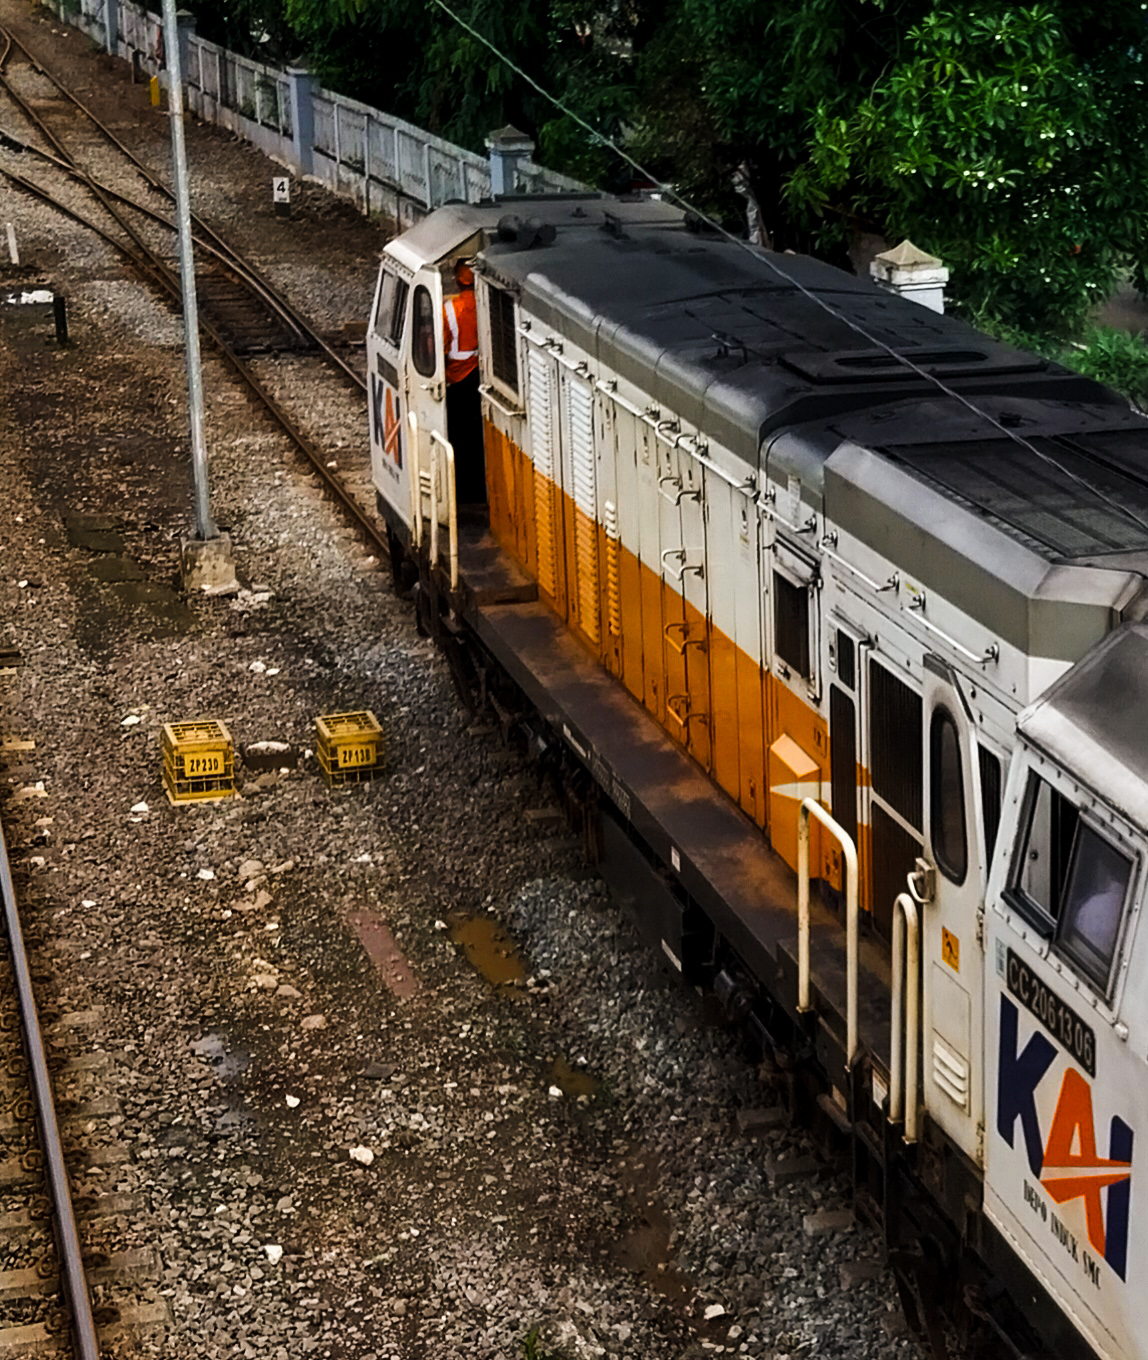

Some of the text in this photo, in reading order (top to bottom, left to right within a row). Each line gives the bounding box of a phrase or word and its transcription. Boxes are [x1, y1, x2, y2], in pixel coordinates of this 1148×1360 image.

[276, 181, 286, 193] 4
[371, 371, 403, 471] KAI
[997, 991, 1135, 1283] KAI
